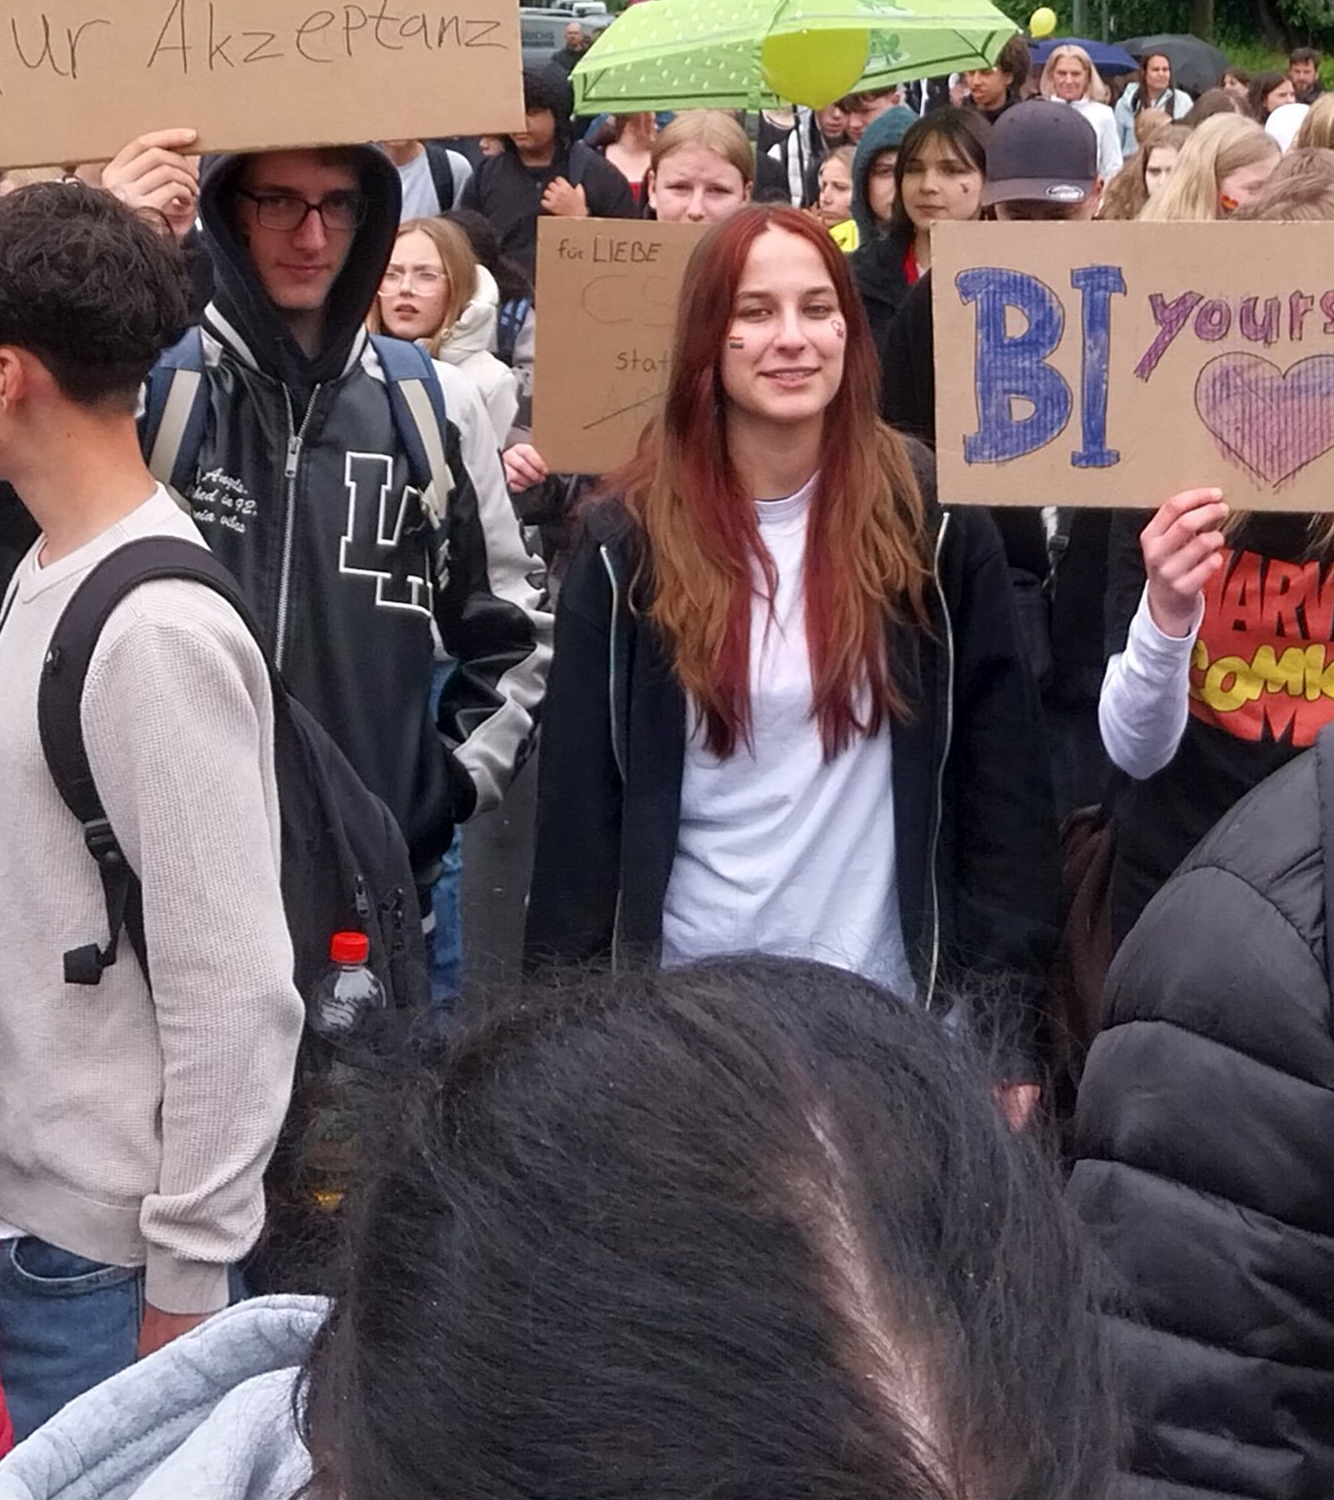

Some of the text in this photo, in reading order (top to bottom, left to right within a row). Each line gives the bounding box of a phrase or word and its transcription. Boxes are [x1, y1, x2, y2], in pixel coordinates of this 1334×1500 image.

[592, 235, 662, 264] LIEBE
[581, 274, 675, 328] CS
[615, 348, 670, 373] stat
[954, 265, 1127, 469] BI
